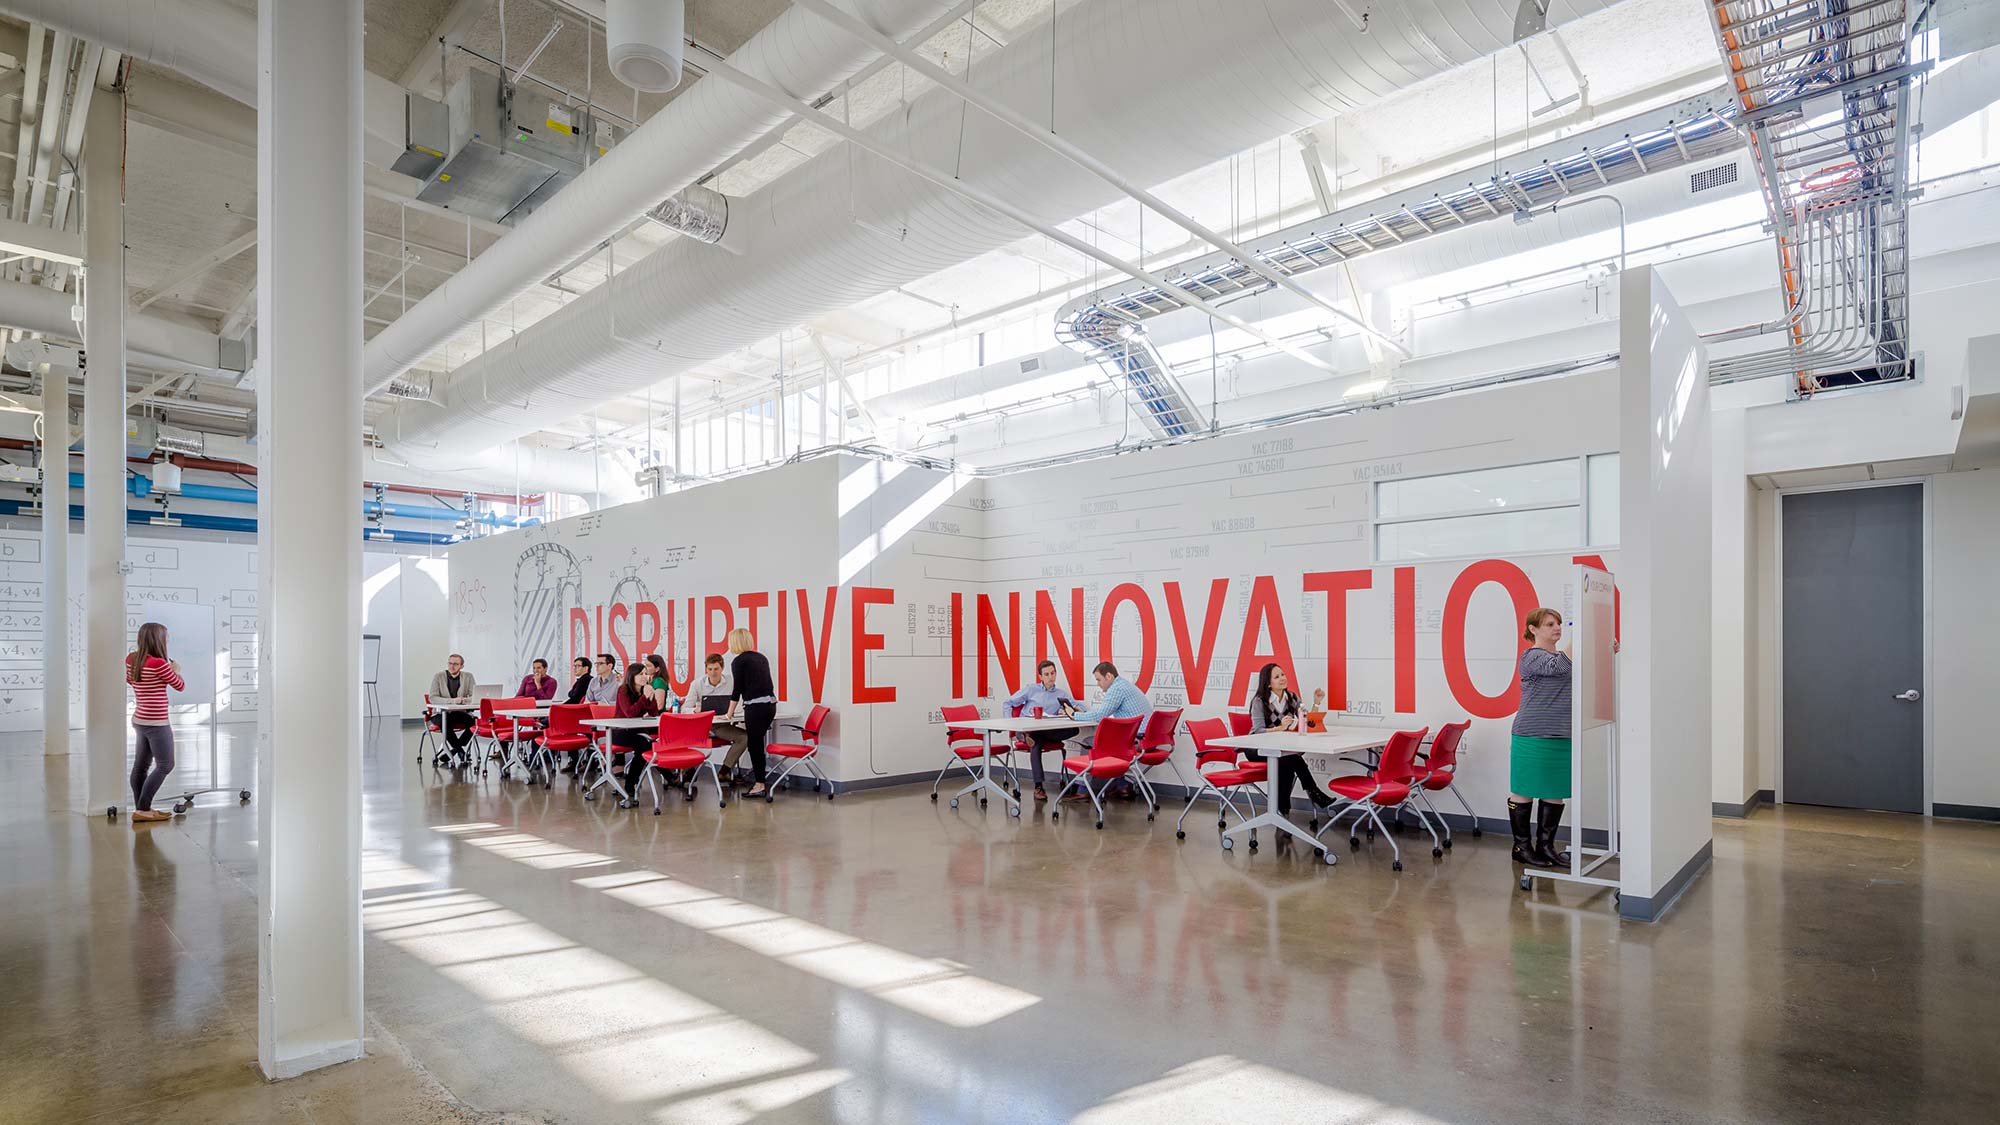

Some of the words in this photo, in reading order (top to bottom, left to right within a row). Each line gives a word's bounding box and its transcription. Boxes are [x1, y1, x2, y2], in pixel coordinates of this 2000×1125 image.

[2, 543, 15, 556] b
[145, 552, 156, 564] d
[22, 587, 41, 598] v4
[163, 591, 180, 601] v6
[23, 615, 41, 627] v2
[570, 586, 896, 704] DISRUPTIVE
